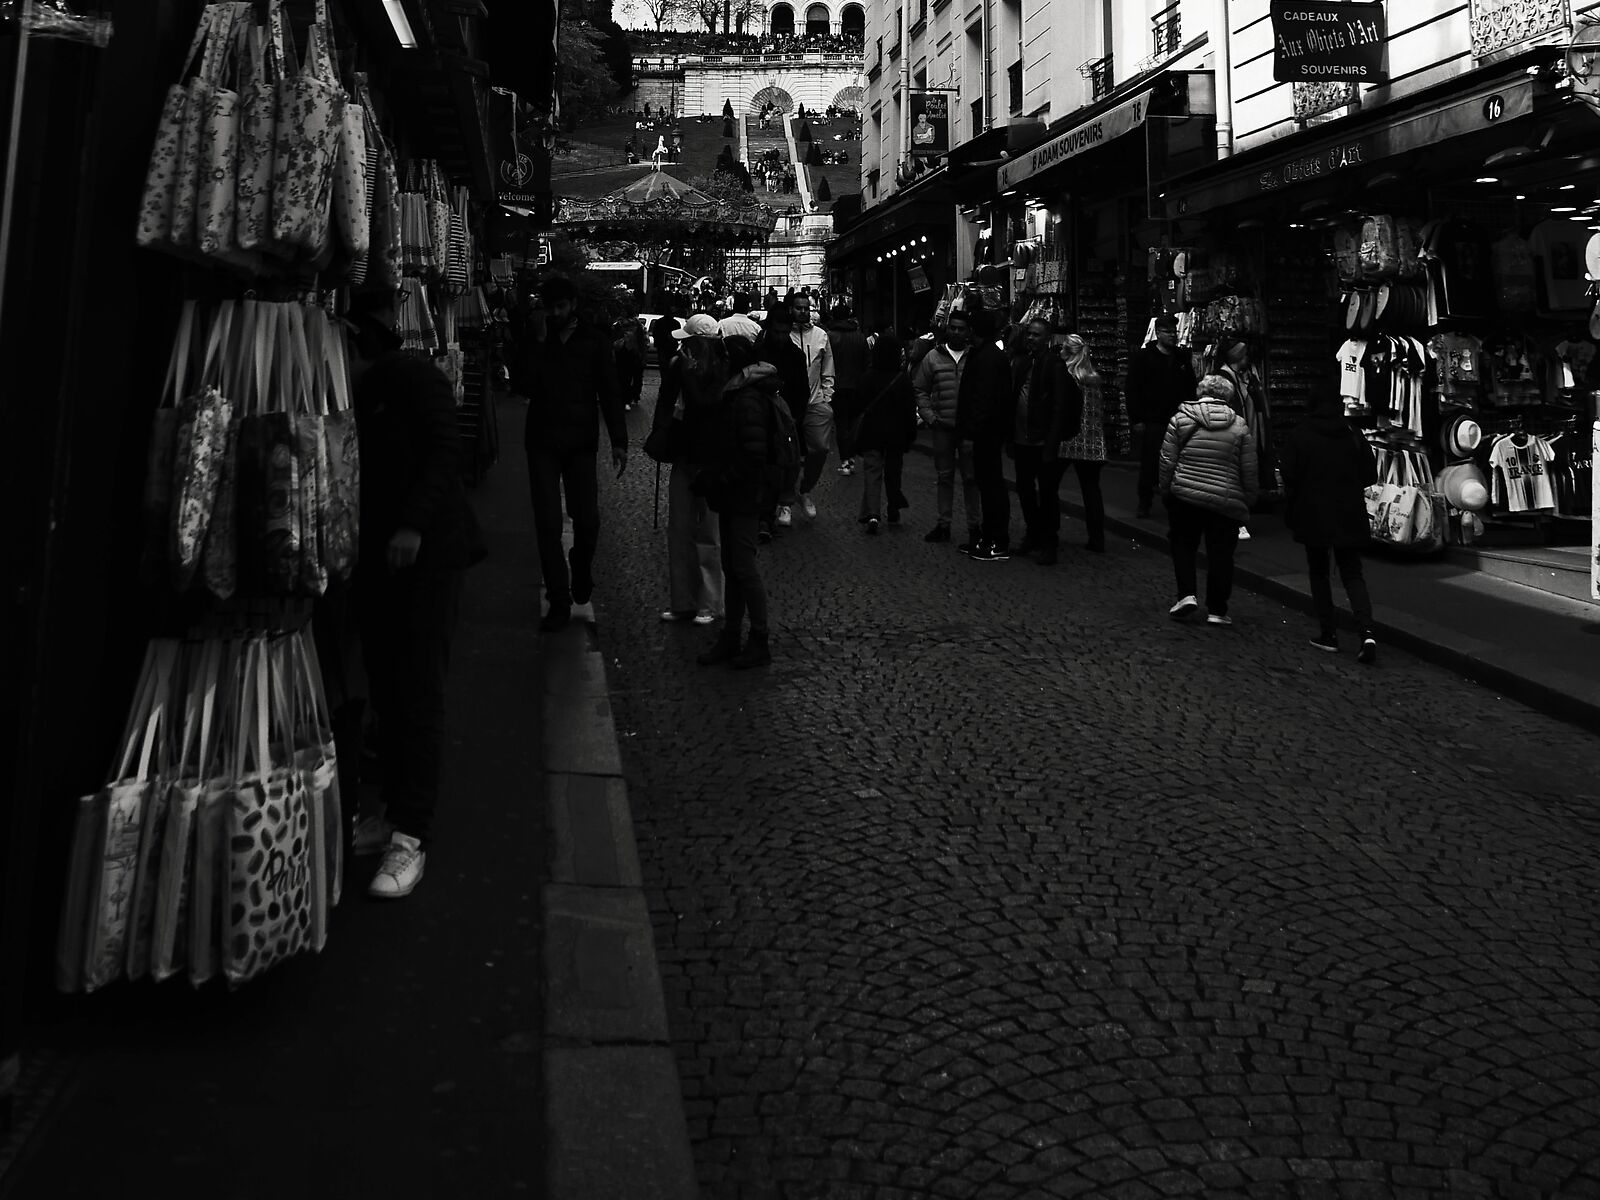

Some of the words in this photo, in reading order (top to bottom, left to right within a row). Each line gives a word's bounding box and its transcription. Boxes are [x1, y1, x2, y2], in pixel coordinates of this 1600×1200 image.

[1283, 11, 1339, 22] CADEAUX
[1278, 33, 1304, 59] Aux
[1306, 28, 1346, 55] Objets
[1346, 19, 1379, 46] d'Art
[1301, 65, 1368, 75] SOUVENIRS
[1132, 101, 1141, 122] 18
[1489, 100, 1501, 119] 16
[1038, 143, 1059, 168] ADAM
[1059, 122, 1103, 157] SOUVENIRS
[1506, 457, 1516, 467] 10
